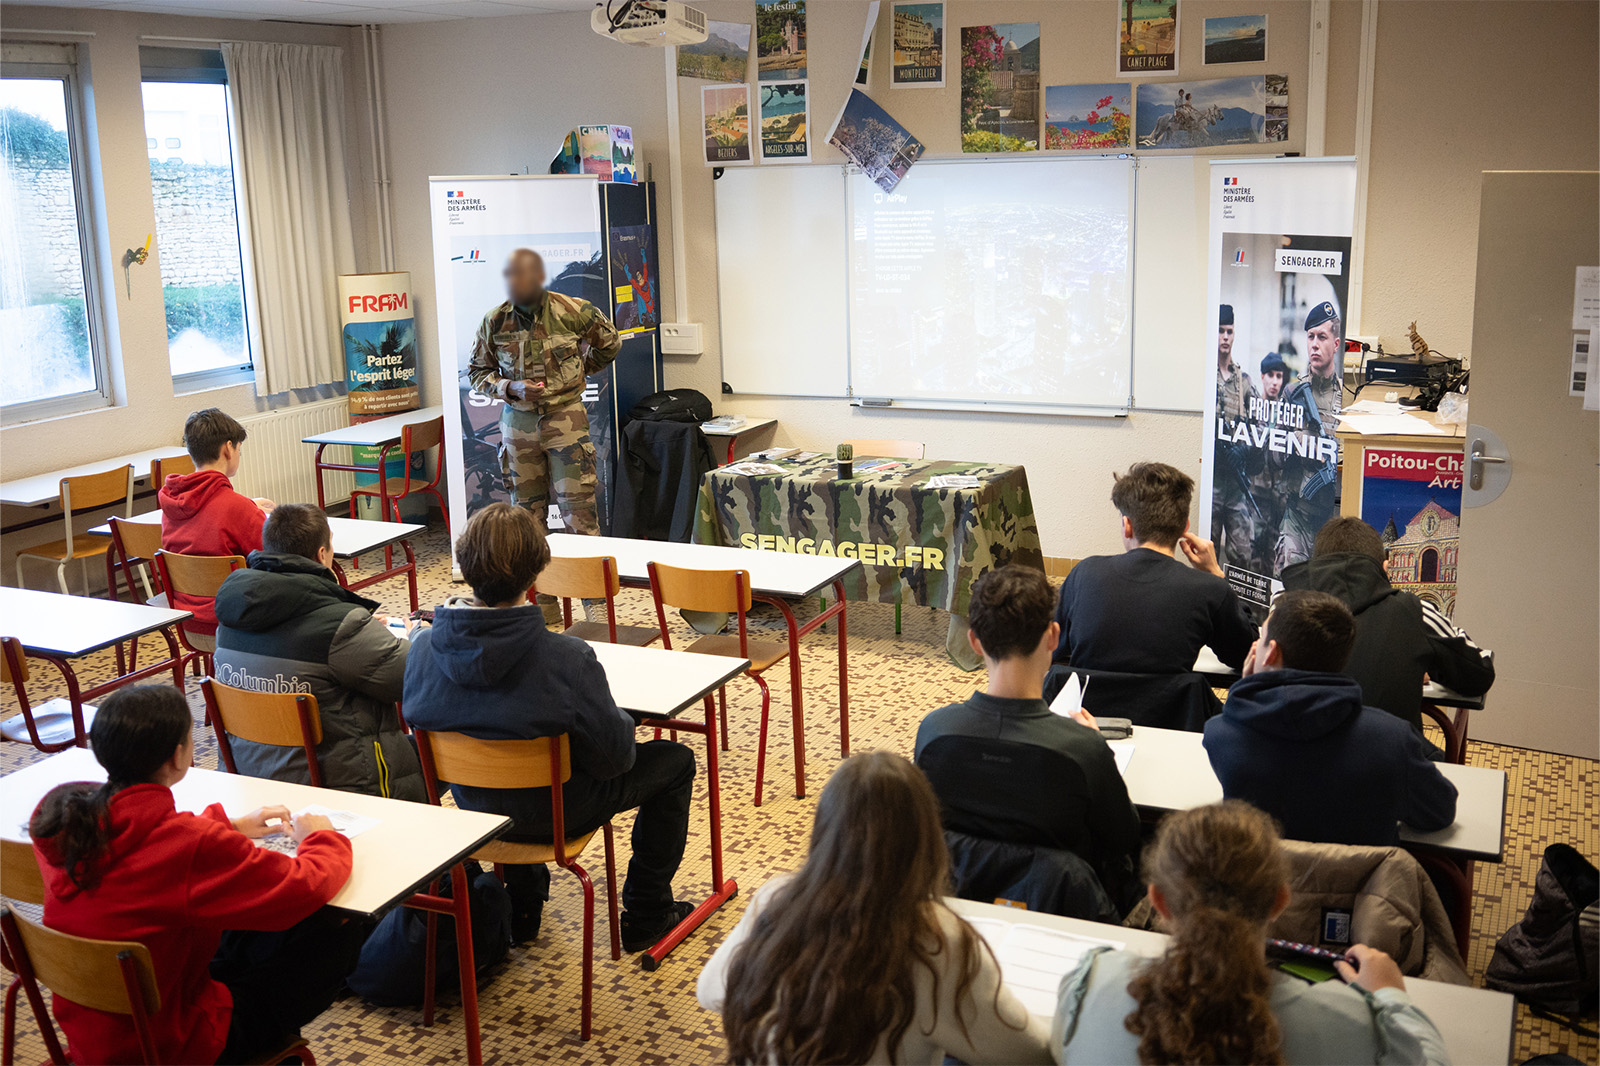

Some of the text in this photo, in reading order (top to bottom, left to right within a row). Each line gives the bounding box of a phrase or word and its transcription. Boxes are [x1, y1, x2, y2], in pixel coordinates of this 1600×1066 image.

[764, 1, 797, 12] le festin
[1127, 56, 1168, 68] CANET PLAGE
[899, 68, 937, 79] MONTPELLIER
[581, 127, 608, 135] CHILE
[1223, 187, 1251, 195] MINISTÈRE
[886, 194, 908, 204] AirPlay
[1234, 194, 1255, 202] ARMÉES
[1281, 255, 1336, 268] SENGAGER.FR
[348, 292, 408, 313] FRAM
[367, 354, 403, 366] Partez
[350, 366, 416, 384] l'esprit léger
[368, 402, 387, 410] repartir
[1248, 395, 1304, 429] PROTÉGER
[1217, 418, 1338, 464] L'AVENIR
[1367, 452, 1464, 472] Poitou-Cha
[1427, 475, 1462, 490] Art
[739, 531, 945, 570] SENGAGER.FR
[1229, 570, 1267, 588] L'ARMÉE DE TERRE
[1252, 591, 1266, 602] FORME
[220, 662, 312, 694] Columbia
